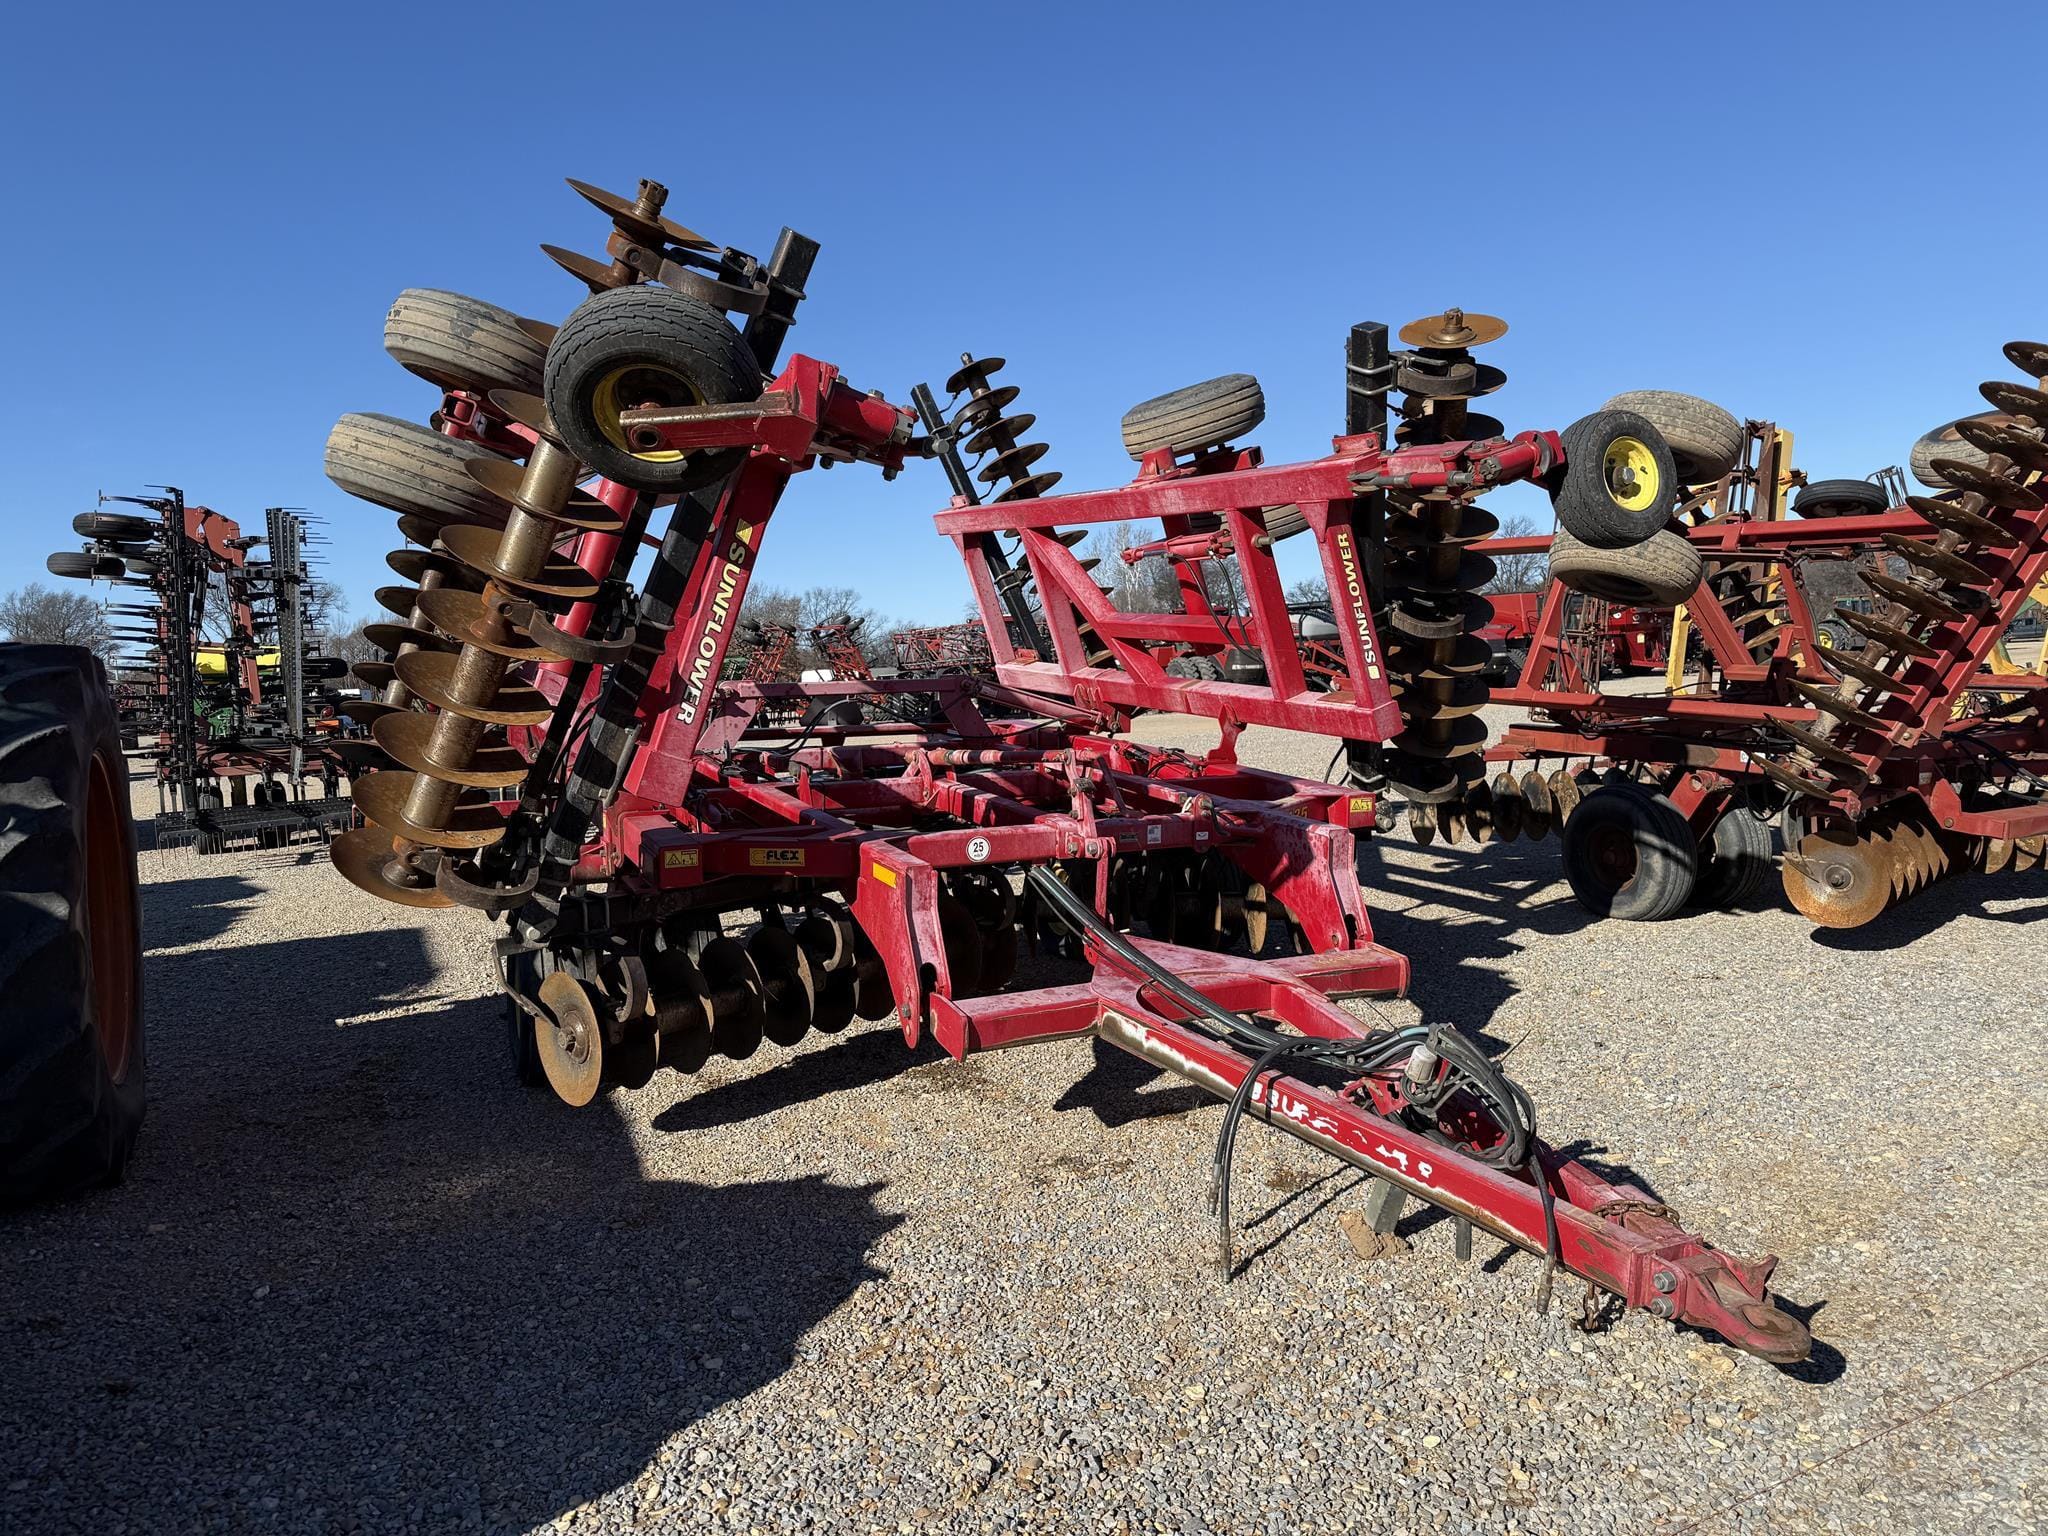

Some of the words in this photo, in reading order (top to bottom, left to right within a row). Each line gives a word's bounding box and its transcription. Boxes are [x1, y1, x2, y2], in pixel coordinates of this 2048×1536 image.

[677, 542, 746, 725] SUNFLOWER
[1338, 533, 1377, 664] SUNFLOWER
[766, 850, 799, 860] FLEX
[973, 842, 984, 853] 25
